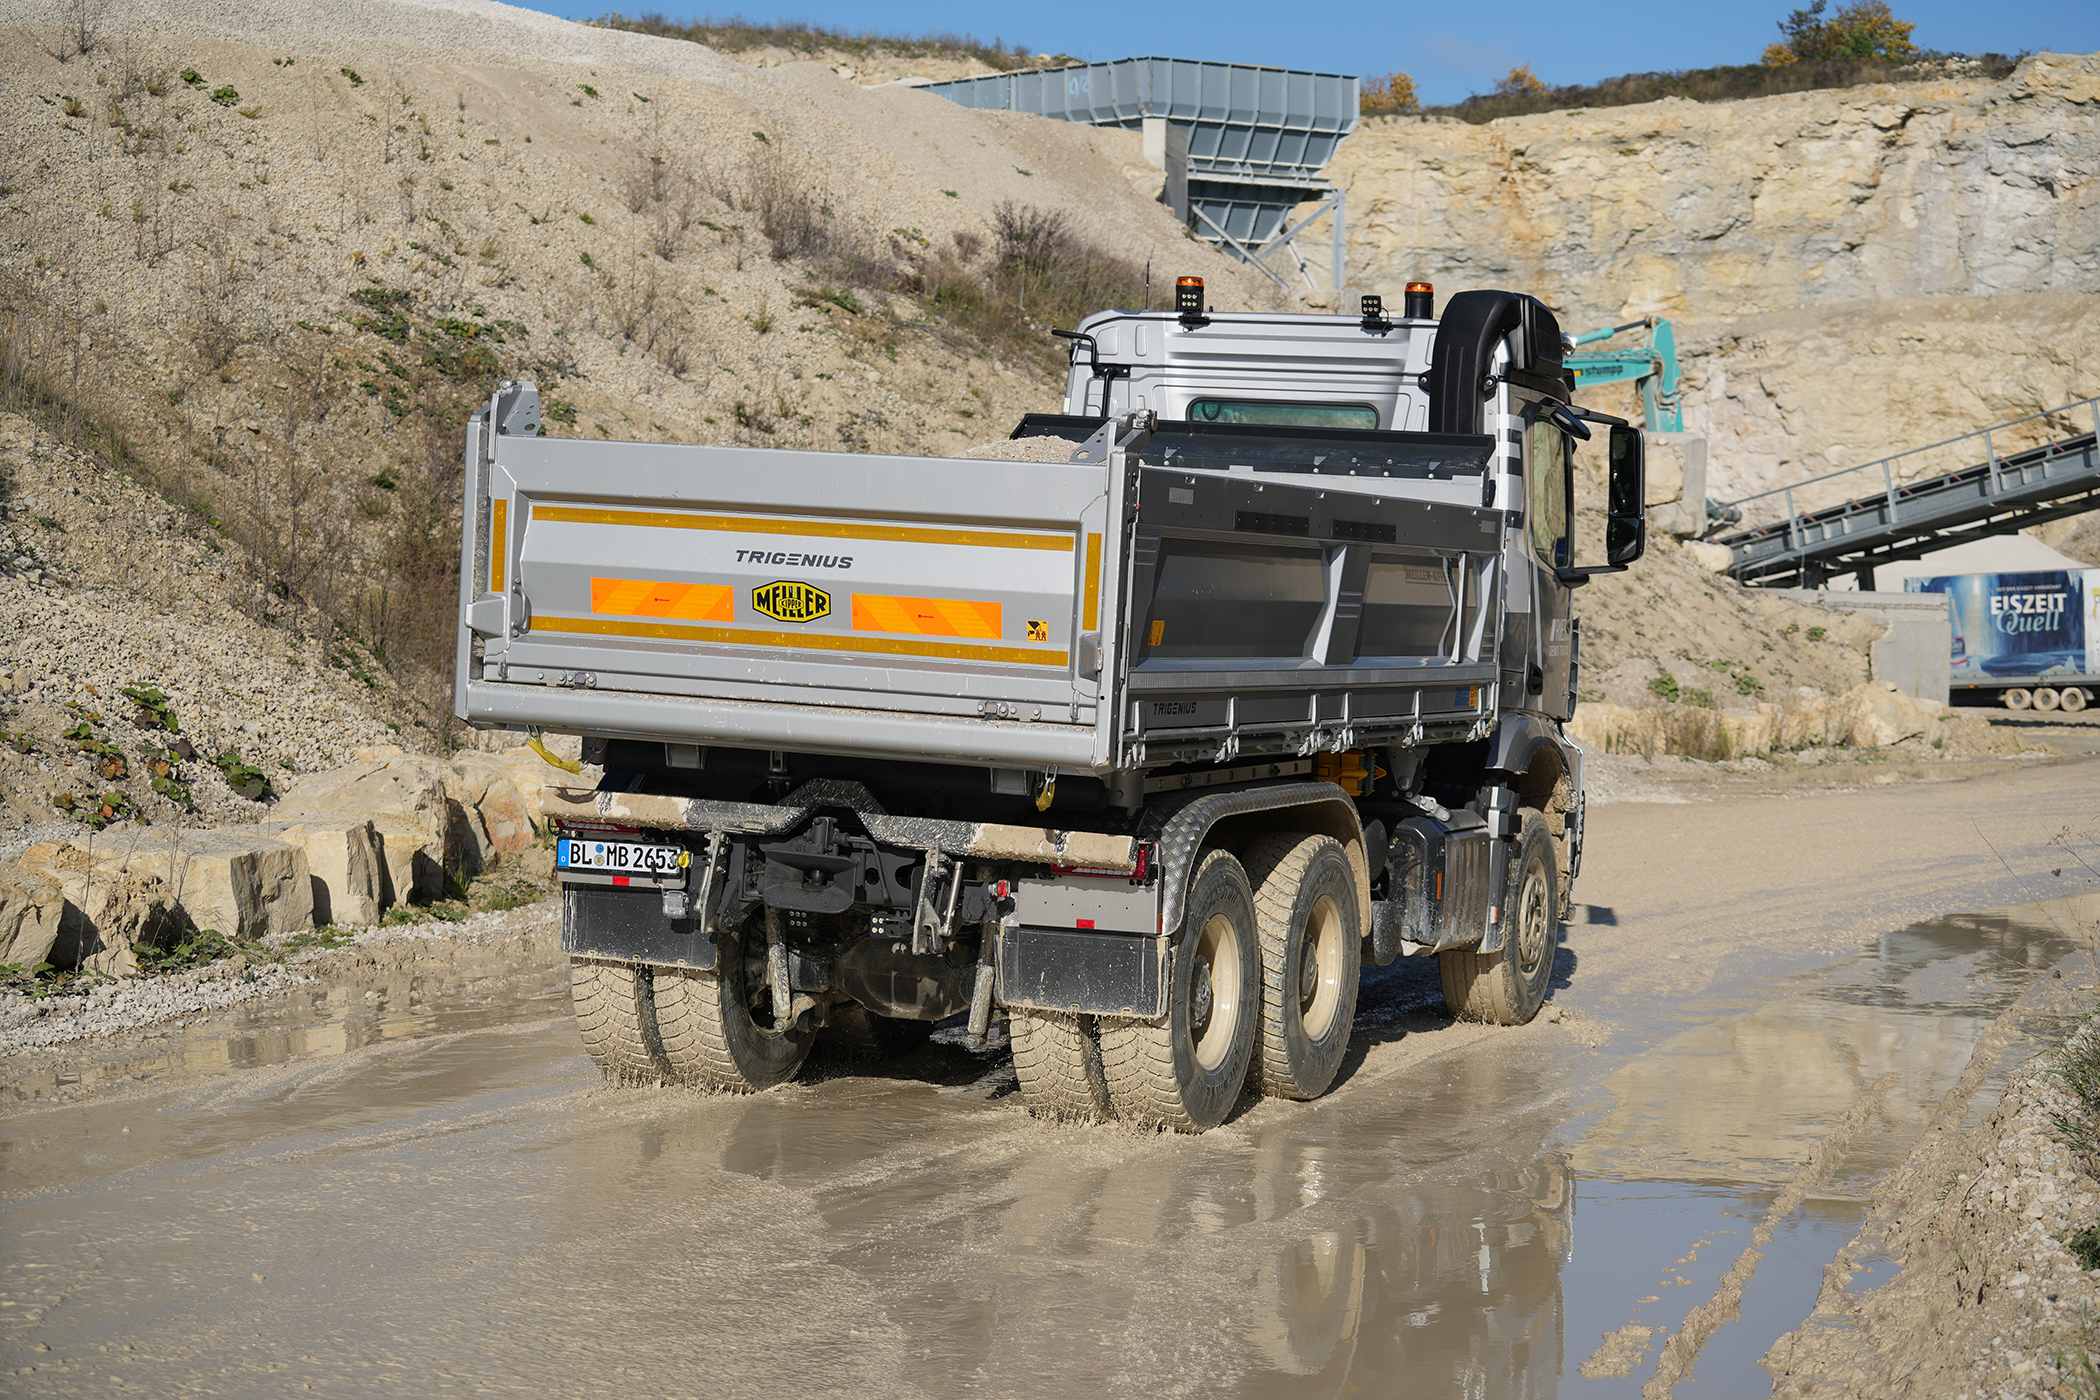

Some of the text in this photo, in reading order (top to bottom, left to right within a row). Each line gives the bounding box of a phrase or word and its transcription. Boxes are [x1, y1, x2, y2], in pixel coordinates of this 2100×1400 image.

[736, 549, 854, 569] TRIGENIUS
[756, 585, 827, 618] MEILLER
[781, 598, 802, 609] KIPPER
[1990, 593, 2067, 615] EISZEIT
[1996, 608, 2060, 636] Quell
[1153, 701, 1197, 715] TRIGENIUS
[570, 843, 677, 870] BL MB 2653
